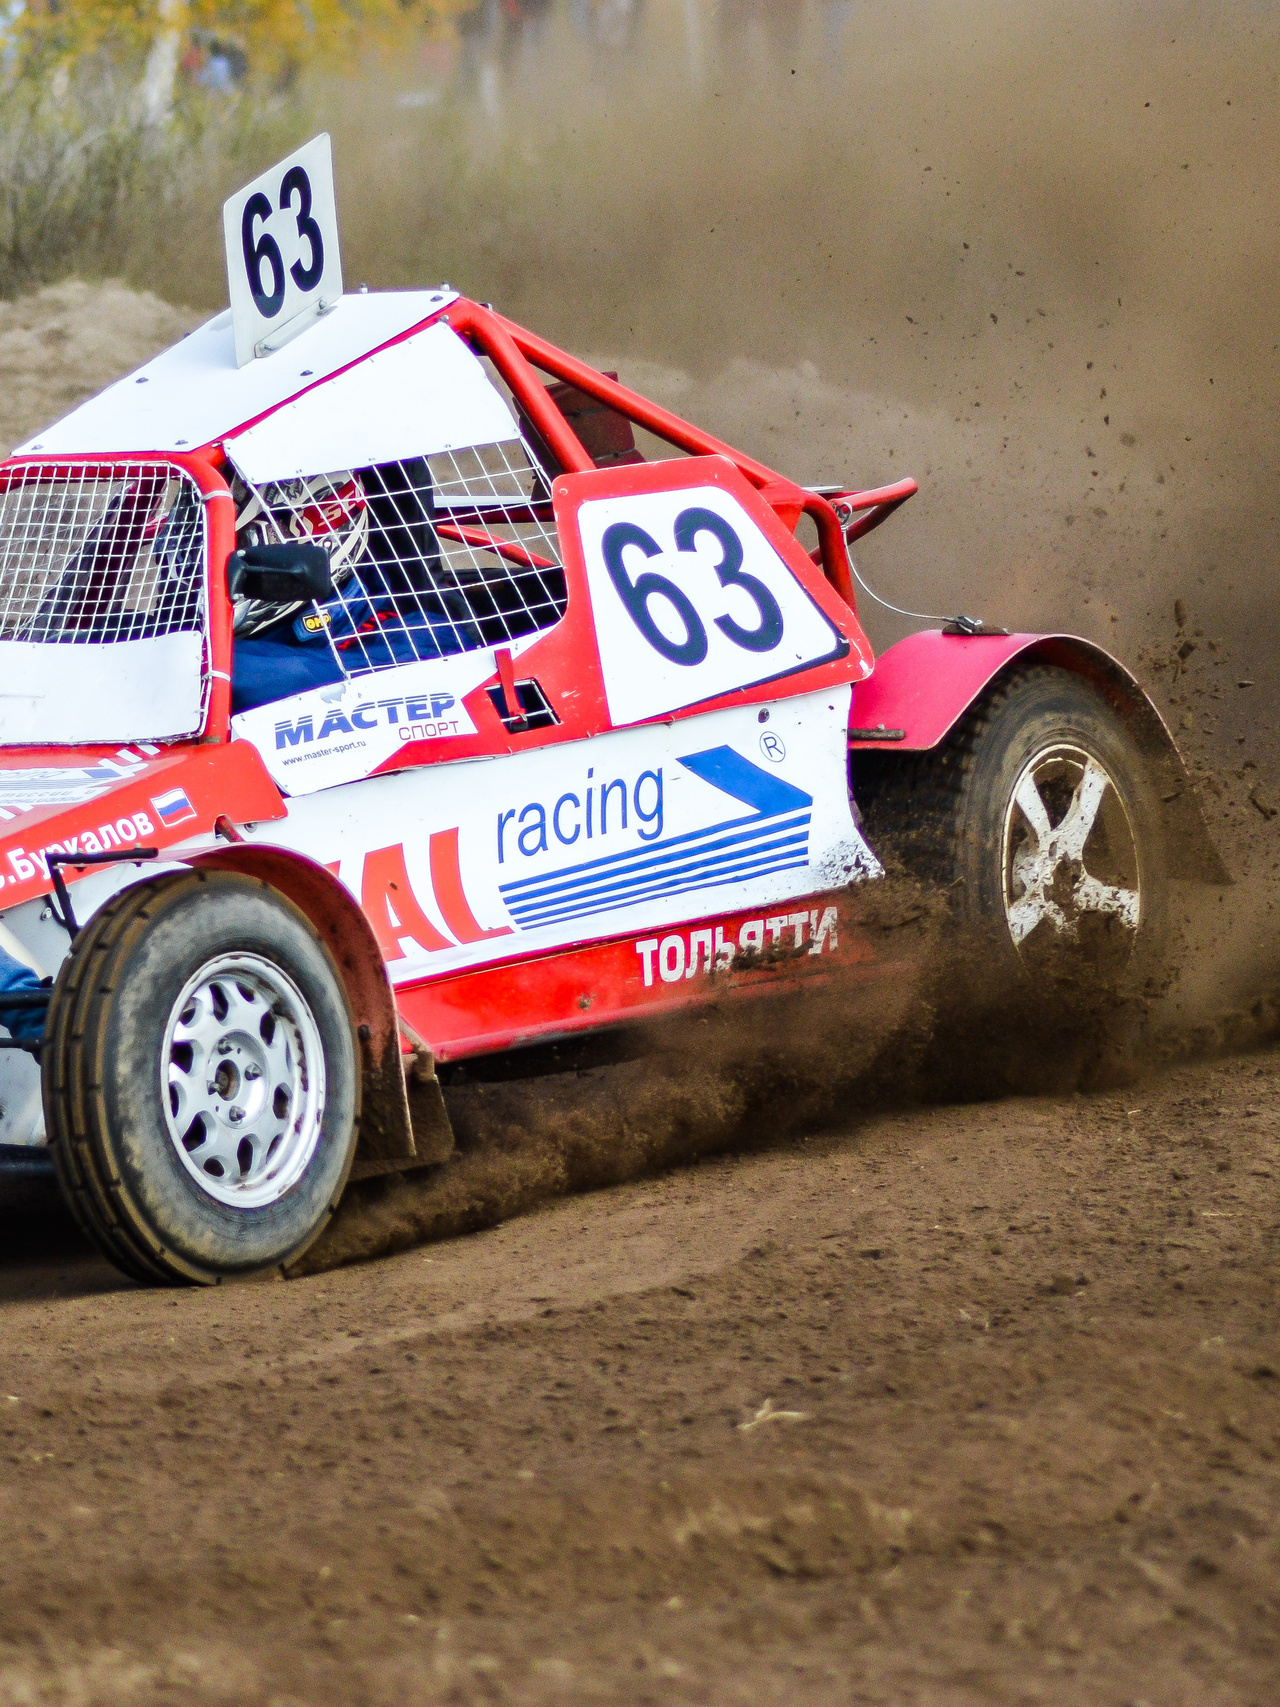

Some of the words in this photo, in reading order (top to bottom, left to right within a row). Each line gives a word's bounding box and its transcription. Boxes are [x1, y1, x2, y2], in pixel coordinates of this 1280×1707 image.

[242, 166, 324, 318] 63
[602, 507, 784, 667] 63
[275, 692, 455, 750] МАСТЕР
[282, 740, 367, 766] www.master-sport.ru
[398, 720, 459, 741] СПОРТ
[324, 827, 515, 962] AL
[497, 768, 664, 865] racing
[636, 906, 838, 987] ТОЛЬЯТТИ
